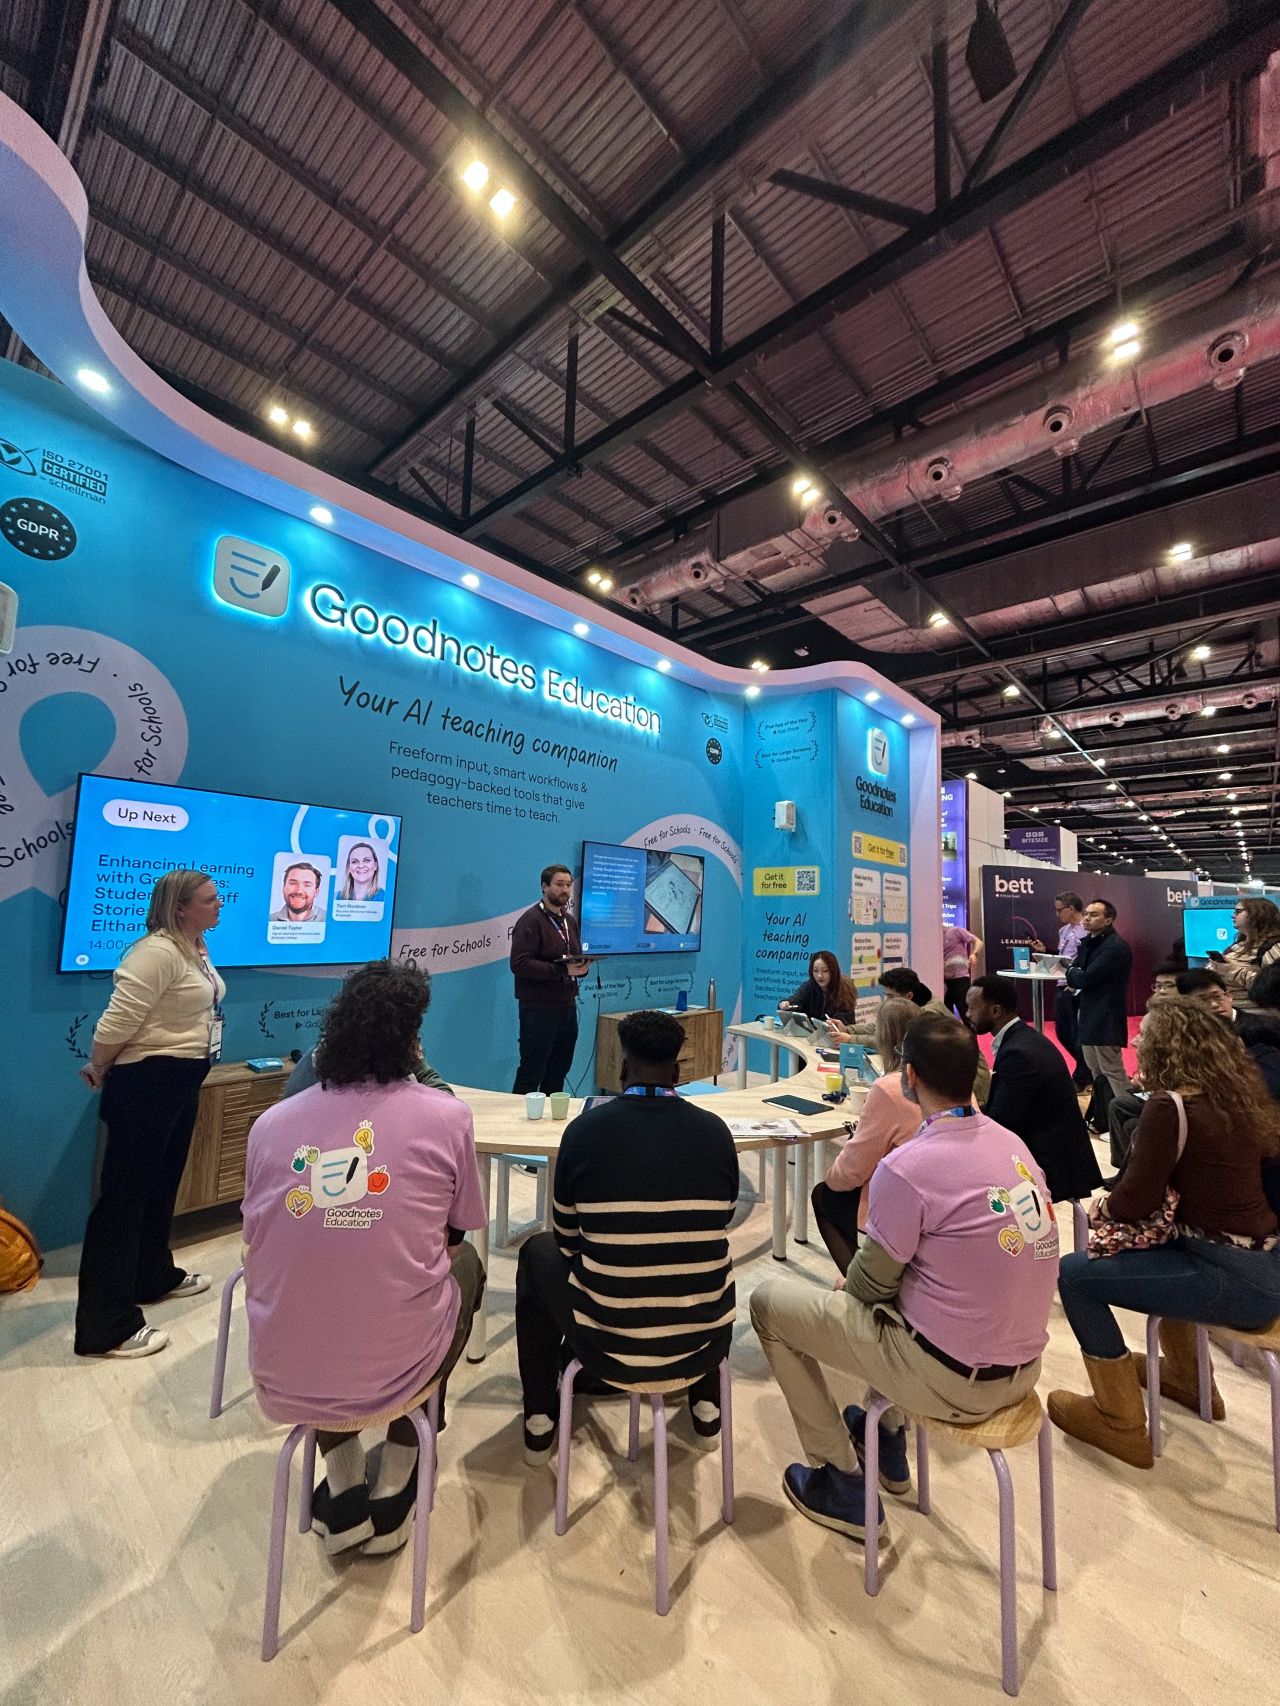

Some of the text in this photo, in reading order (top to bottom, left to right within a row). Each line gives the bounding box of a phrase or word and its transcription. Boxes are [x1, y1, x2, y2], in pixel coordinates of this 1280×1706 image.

[42, 449, 109, 482] ISO 27001
[43, 461, 106, 494] CERTIFIED
[48, 478, 106, 505] schellman
[17, 518, 60, 541] GDPR
[310, 583, 662, 734] Goodnotes Education
[8, 652, 164, 777] for Schools Free for
[339, 674, 618, 773] Your AI teaching companion
[389, 741, 588, 793] Freeform input, smart workflows &
[391, 766, 585, 810] pedagogy-backed tools that give
[855, 775, 897, 803] Goodnotes
[118, 807, 177, 824] Up Next
[426, 791, 561, 824] teachers time to teach.
[860, 794, 894, 818] Education
[0, 820, 74, 868] Schools
[643, 824, 737, 864] Free for Schools Free for Schools
[868, 843, 876, 852] Get
[886, 847, 894, 858] free
[98, 854, 187, 870] Enhancing
[96, 872, 134, 885] with
[761, 881, 787, 889] for free
[764, 873, 784, 881] Get it
[995, 874, 1035, 894] bett
[765, 911, 807, 927] Your AI
[399, 934, 491, 958] Free for Schools
[762, 930, 810, 947] teaching
[274, 1010, 295, 1019] Best
[296, 1009, 311, 1017] for
[325, 1217, 370, 1227] Education
[327, 1208, 382, 1218] Goodnotes
